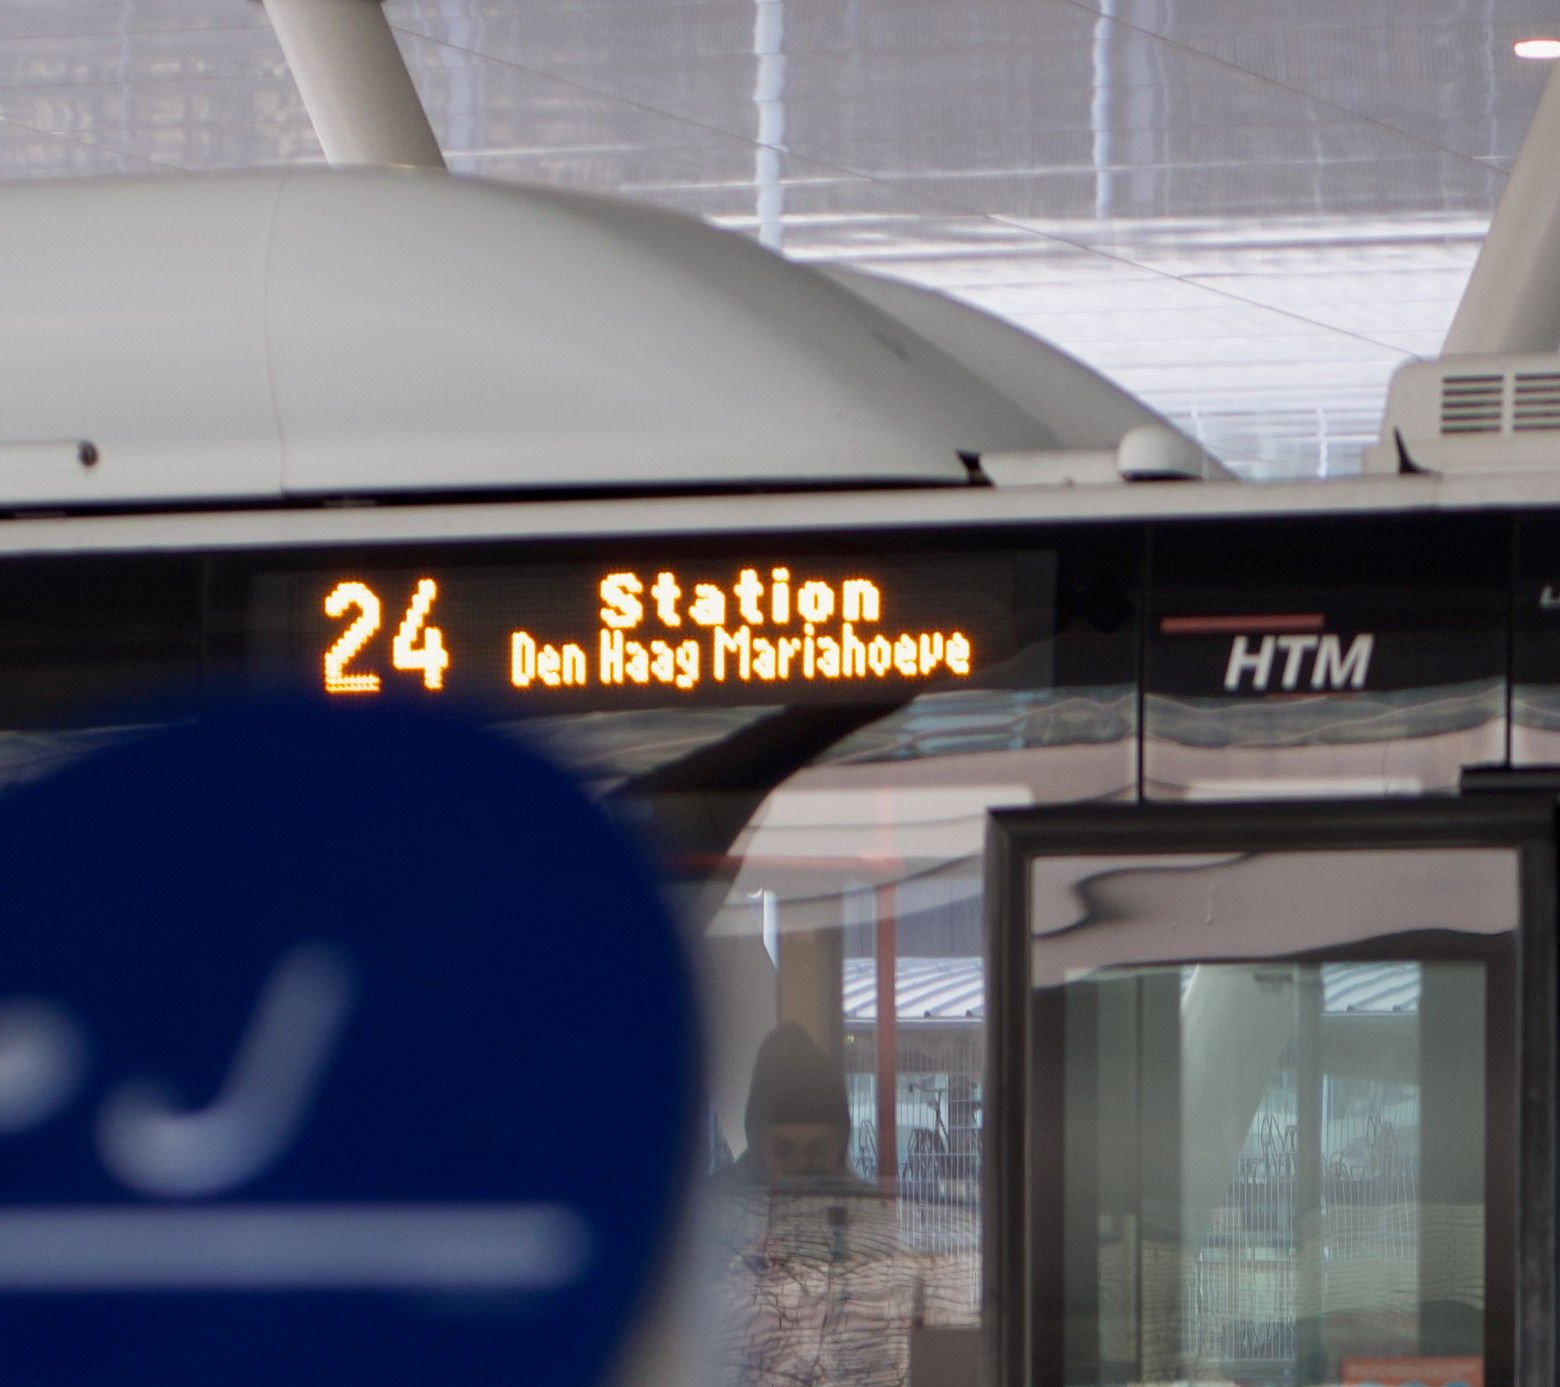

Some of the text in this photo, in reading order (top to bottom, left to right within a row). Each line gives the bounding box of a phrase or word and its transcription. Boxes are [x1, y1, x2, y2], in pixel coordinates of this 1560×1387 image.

[600, 567, 881, 628] Station
[324, 578, 450, 693] 24
[510, 622, 972, 690] Den Haag Mariahoeve
[1223, 633, 1376, 690] HTM
